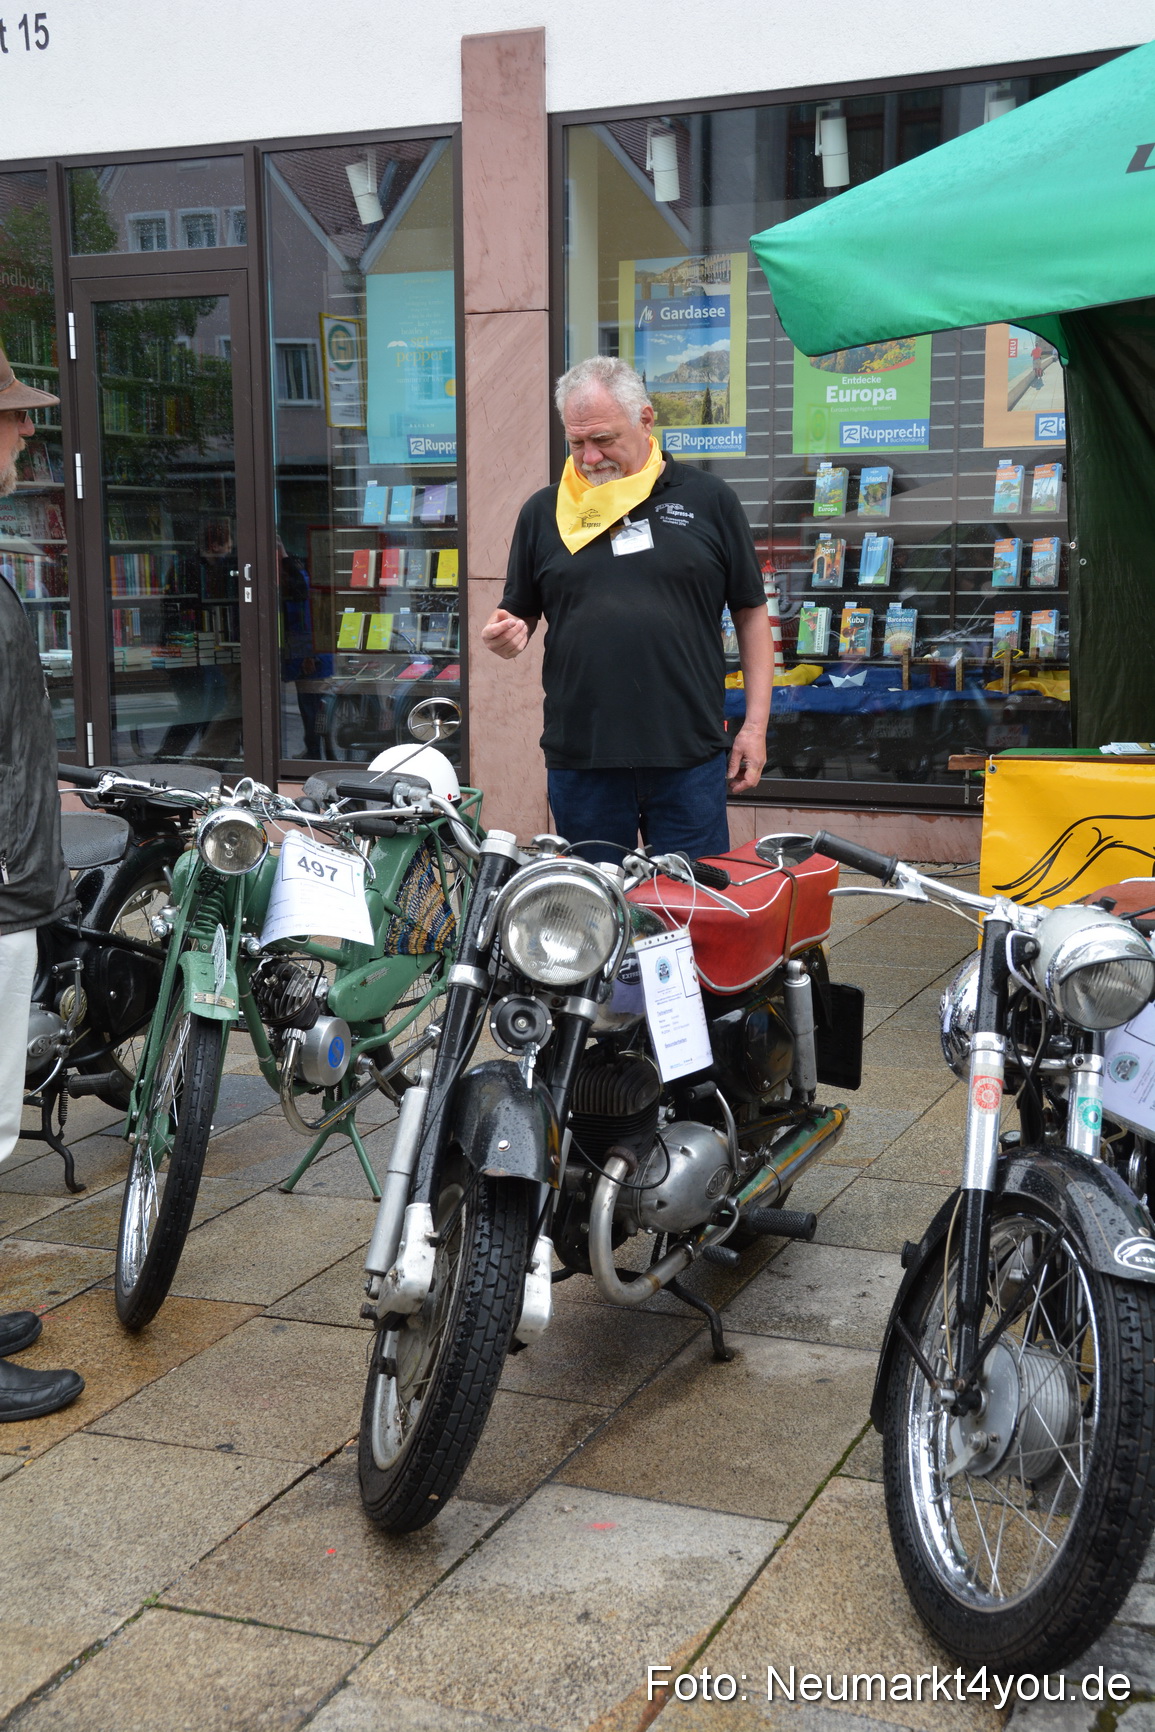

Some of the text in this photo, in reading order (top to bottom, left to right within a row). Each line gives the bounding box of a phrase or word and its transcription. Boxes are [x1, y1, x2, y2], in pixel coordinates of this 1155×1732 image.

[18, 12, 50, 52] 15
[660, 305, 726, 320] Gardasee
[1009, 340, 1017, 357] NEU
[842, 376, 882, 385] Entdecke
[826, 385, 897, 406] Europa
[683, 430, 743, 450] Rupprecht
[861, 423, 926, 443] Rupprecht
[846, 616, 865, 624] Kuba
[297, 856, 338, 882] 497
